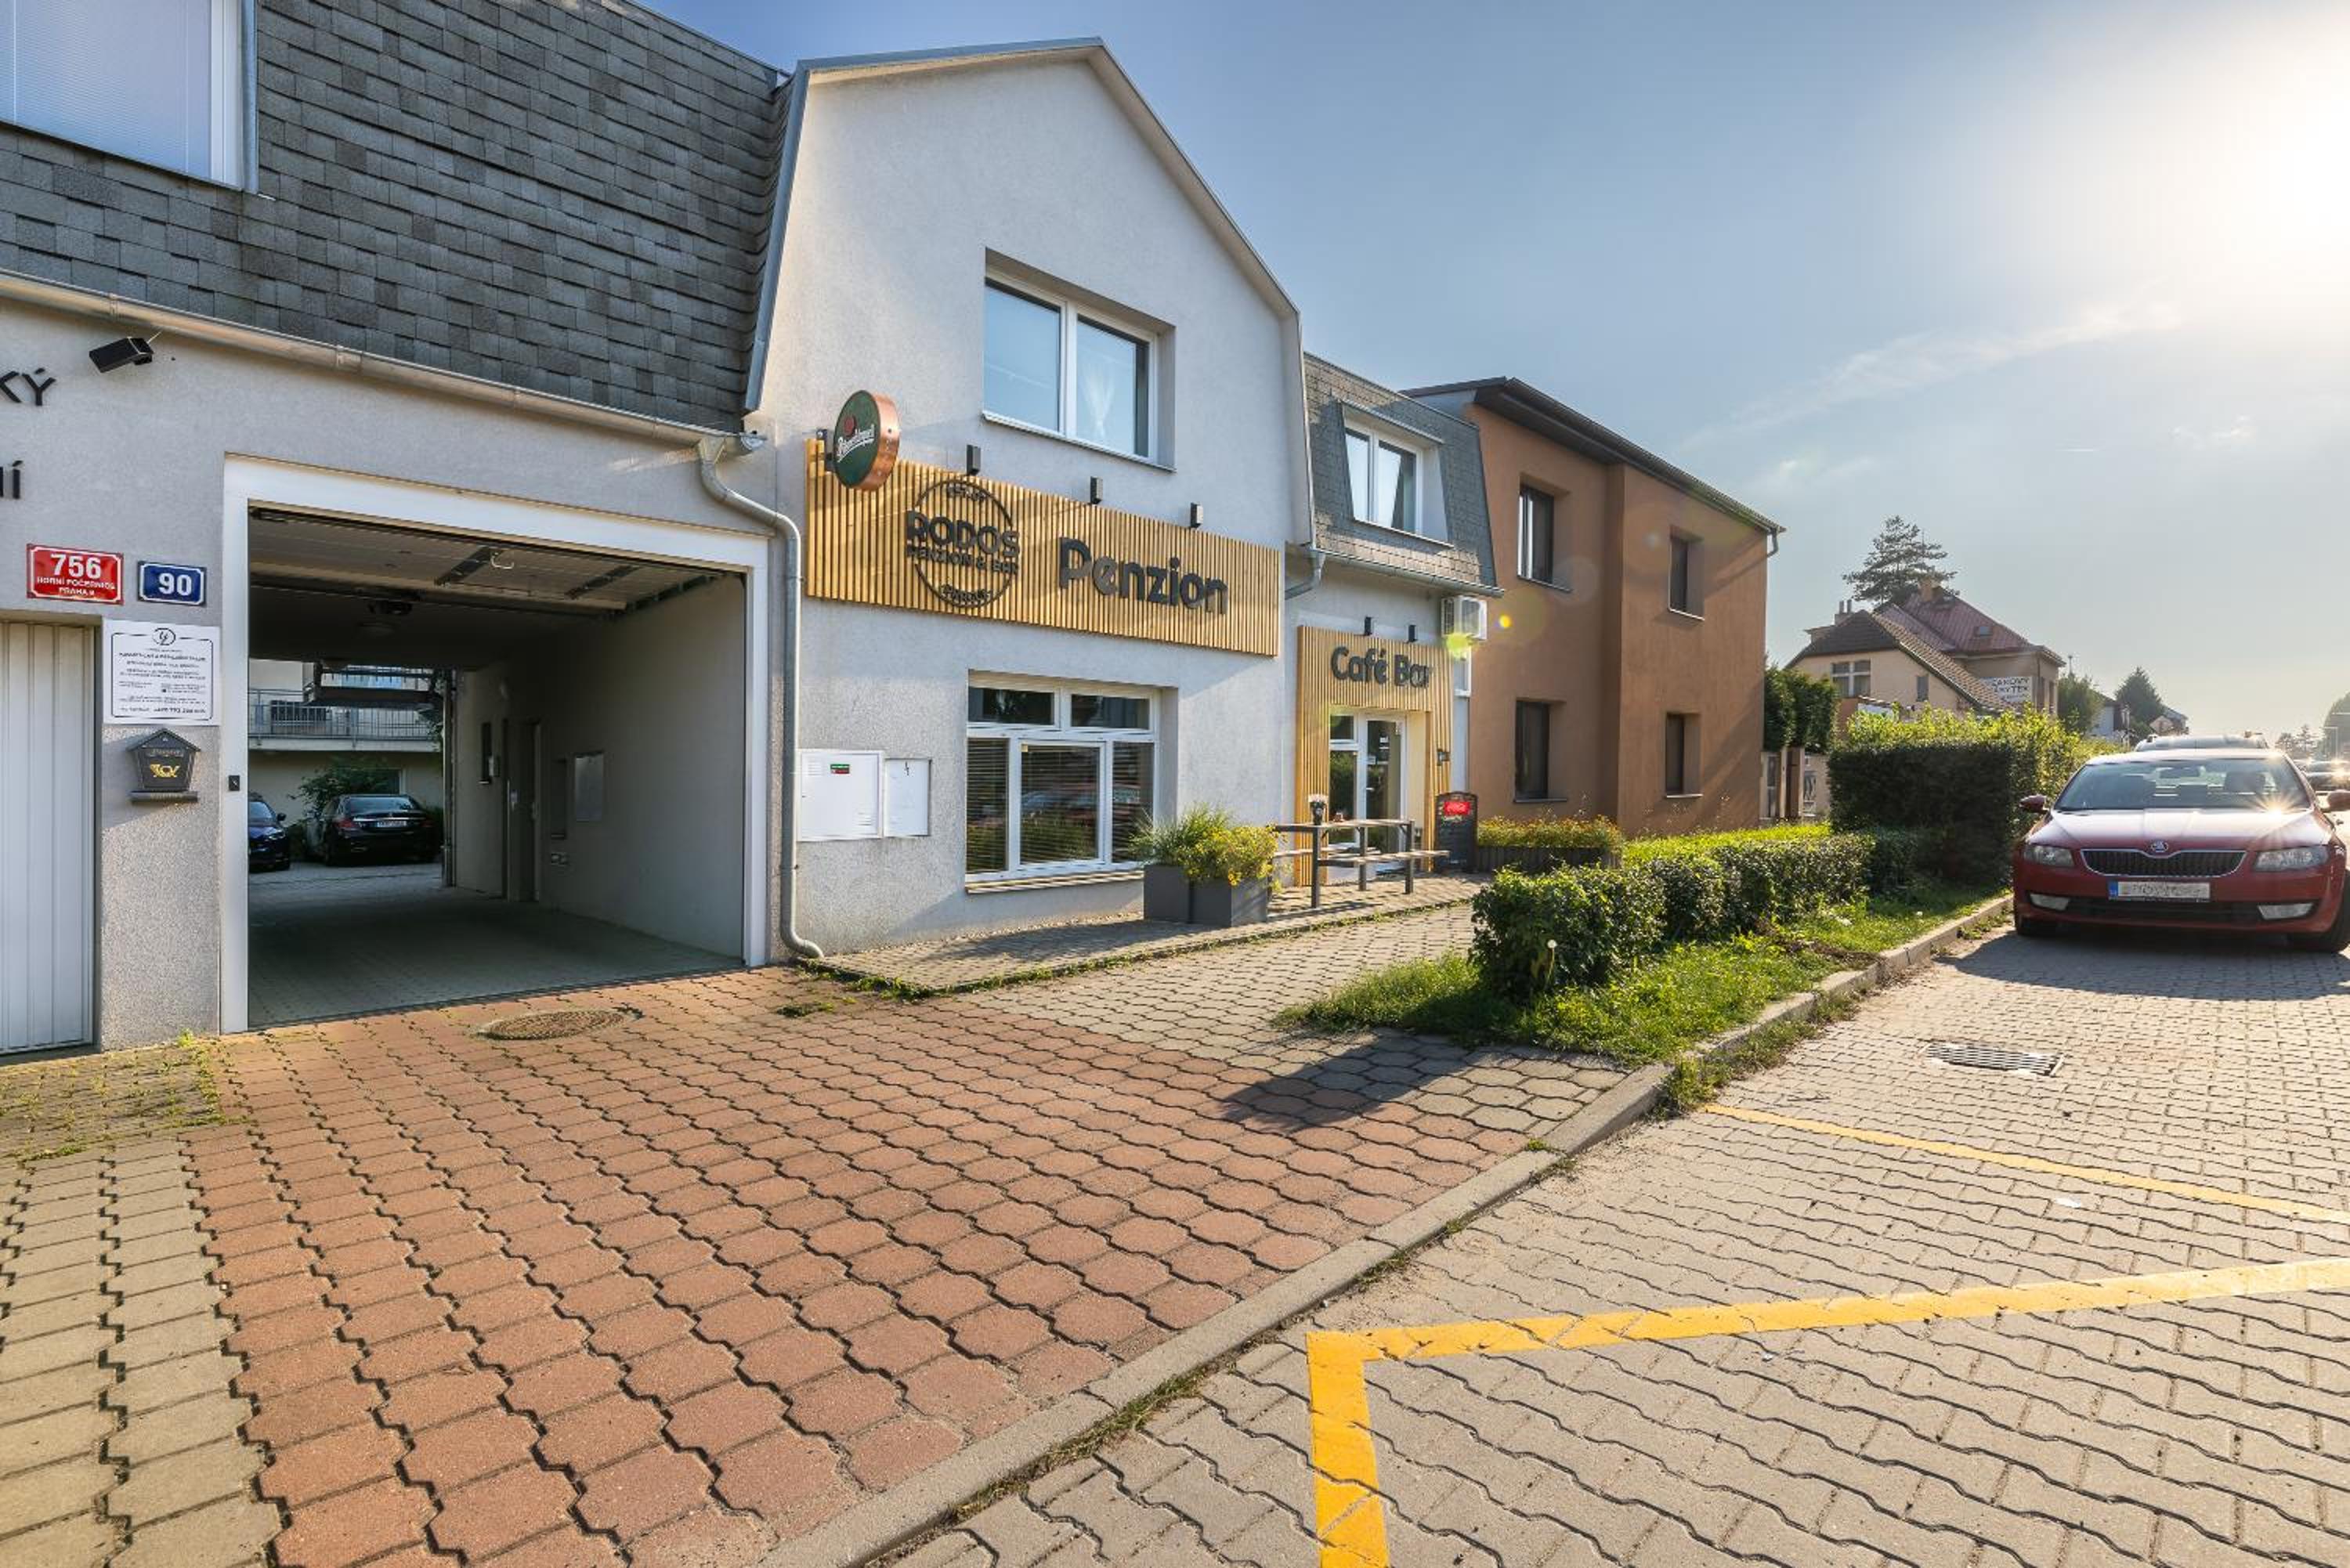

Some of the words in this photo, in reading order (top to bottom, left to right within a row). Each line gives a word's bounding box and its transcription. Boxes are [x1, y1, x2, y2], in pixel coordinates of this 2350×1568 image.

[906, 510, 1020, 558] RODOS
[37, 576, 65, 585] HORNÍ
[50, 553, 102, 580] 756
[1059, 537, 1229, 615] Penzion
[158, 573, 192, 596] 90
[1331, 645, 1389, 685] Café
[1394, 654, 1430, 689] Bar
